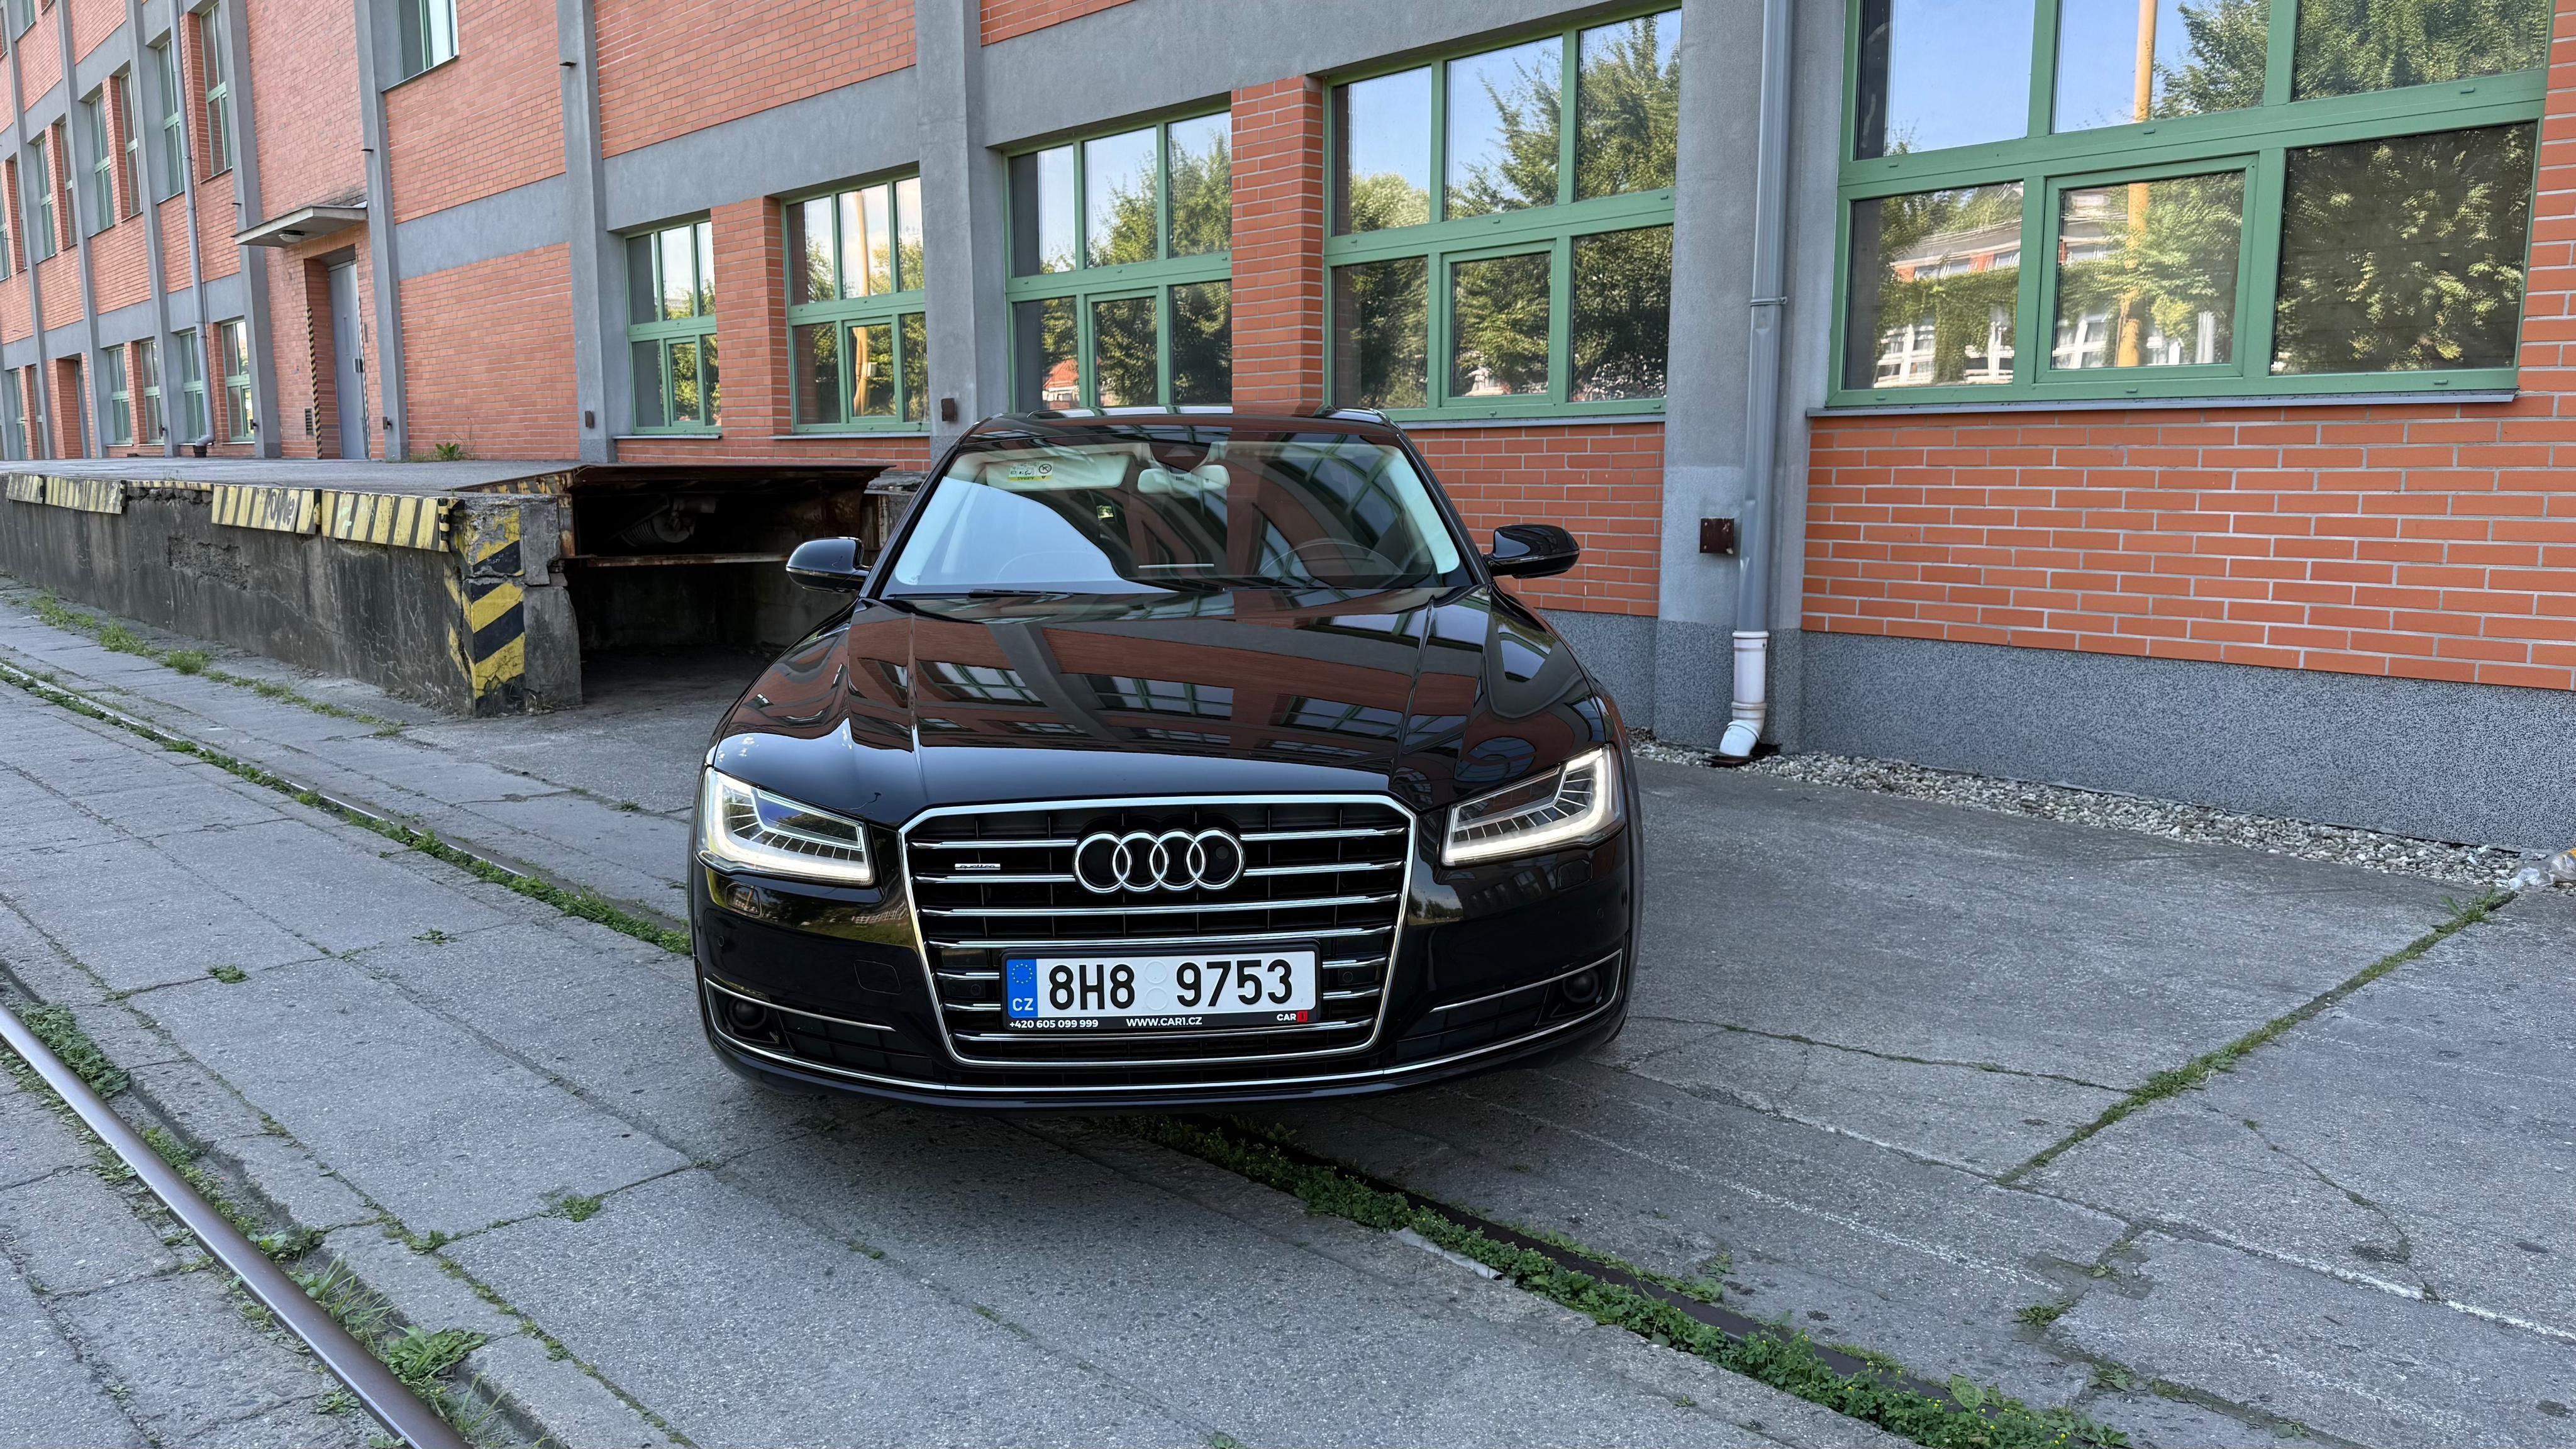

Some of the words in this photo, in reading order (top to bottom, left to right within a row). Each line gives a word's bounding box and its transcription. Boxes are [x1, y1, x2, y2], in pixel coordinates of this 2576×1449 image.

[1048, 964, 1136, 1010] 8H8
[1176, 959, 1292, 1007] 9753
[1012, 997, 1034, 1011] CZ
[1009, 1020, 1034, 1028] +420
[1036, 1019, 1056, 1028] 605
[1058, 1019, 1077, 1028] 099
[1079, 1019, 1099, 1028] 999
[1126, 1016, 1202, 1027] WWW.CAR1.CZ
